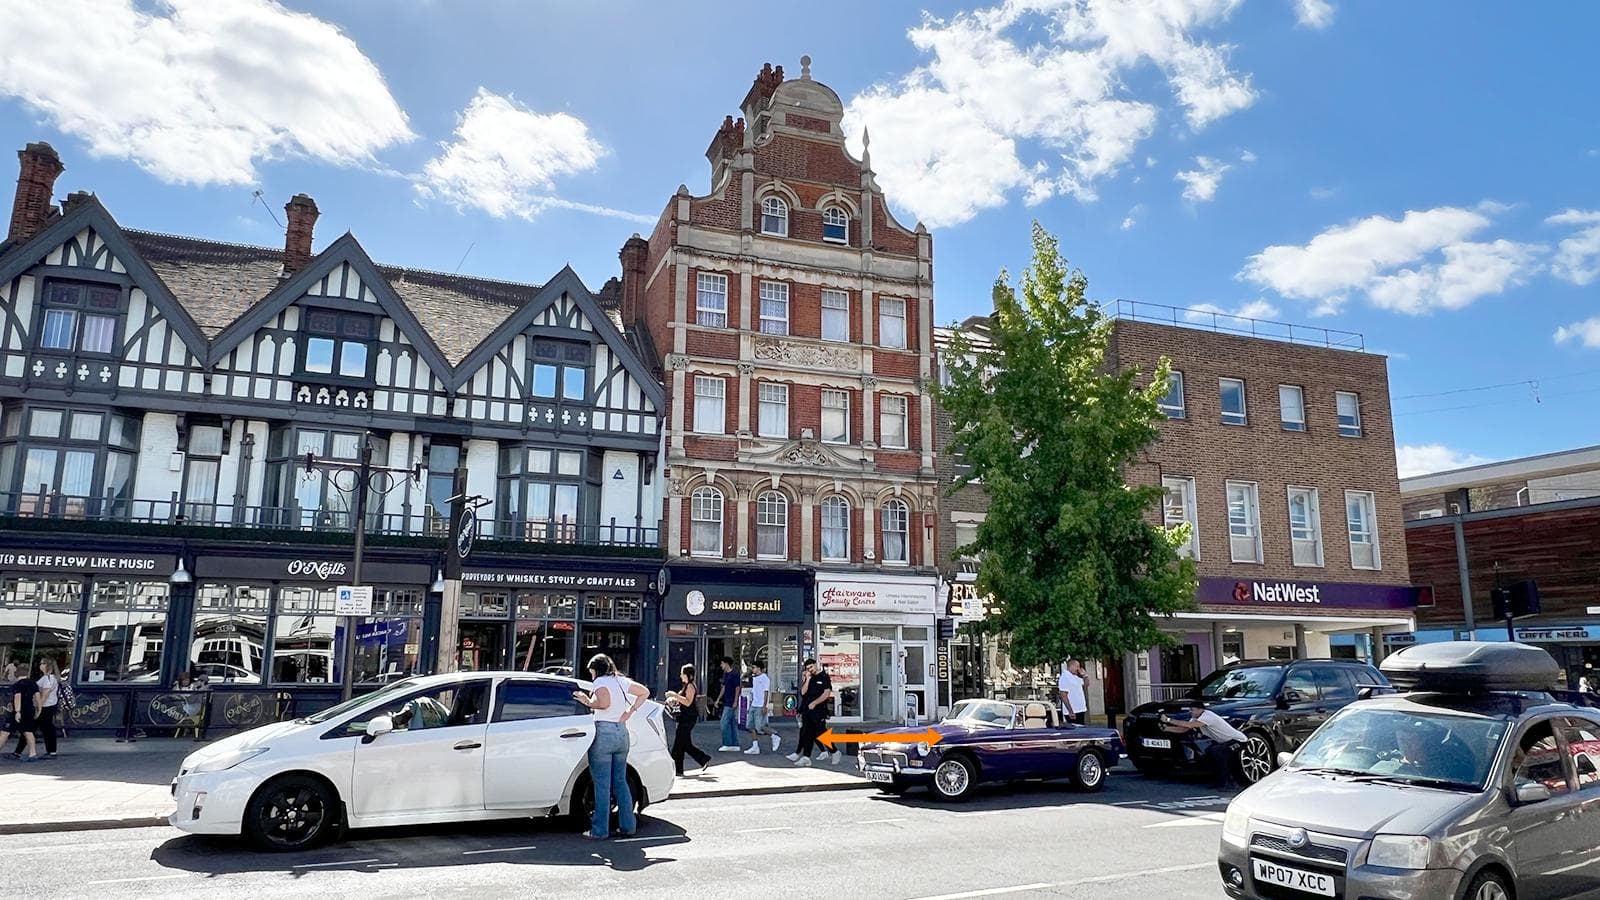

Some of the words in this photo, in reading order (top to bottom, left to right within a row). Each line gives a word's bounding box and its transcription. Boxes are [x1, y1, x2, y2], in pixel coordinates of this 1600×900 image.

[28, 555, 52, 567] LIFE
[55, 556, 88, 568] FLOW
[90, 557, 117, 569] LIKE
[119, 558, 156, 570] MUSIC
[496, 573, 505, 582] OF
[548, 575, 576, 585] STOUT
[586, 577, 614, 587] CRAFT
[615, 578, 636, 587] ALES
[822, 587, 876, 599] Hairwaves
[1253, 581, 1321, 604] NatWest
[712, 600, 743, 611] SALON
[744, 601, 757, 611] DE
[822, 597, 850, 607] Beauty
[852, 597, 876, 606] Centre
[1556, 630, 1589, 639] NERO
[938, 655, 948, 678] GOLD
[1259, 863, 1293, 885] WP07
[1297, 872, 1327, 892] XCC
